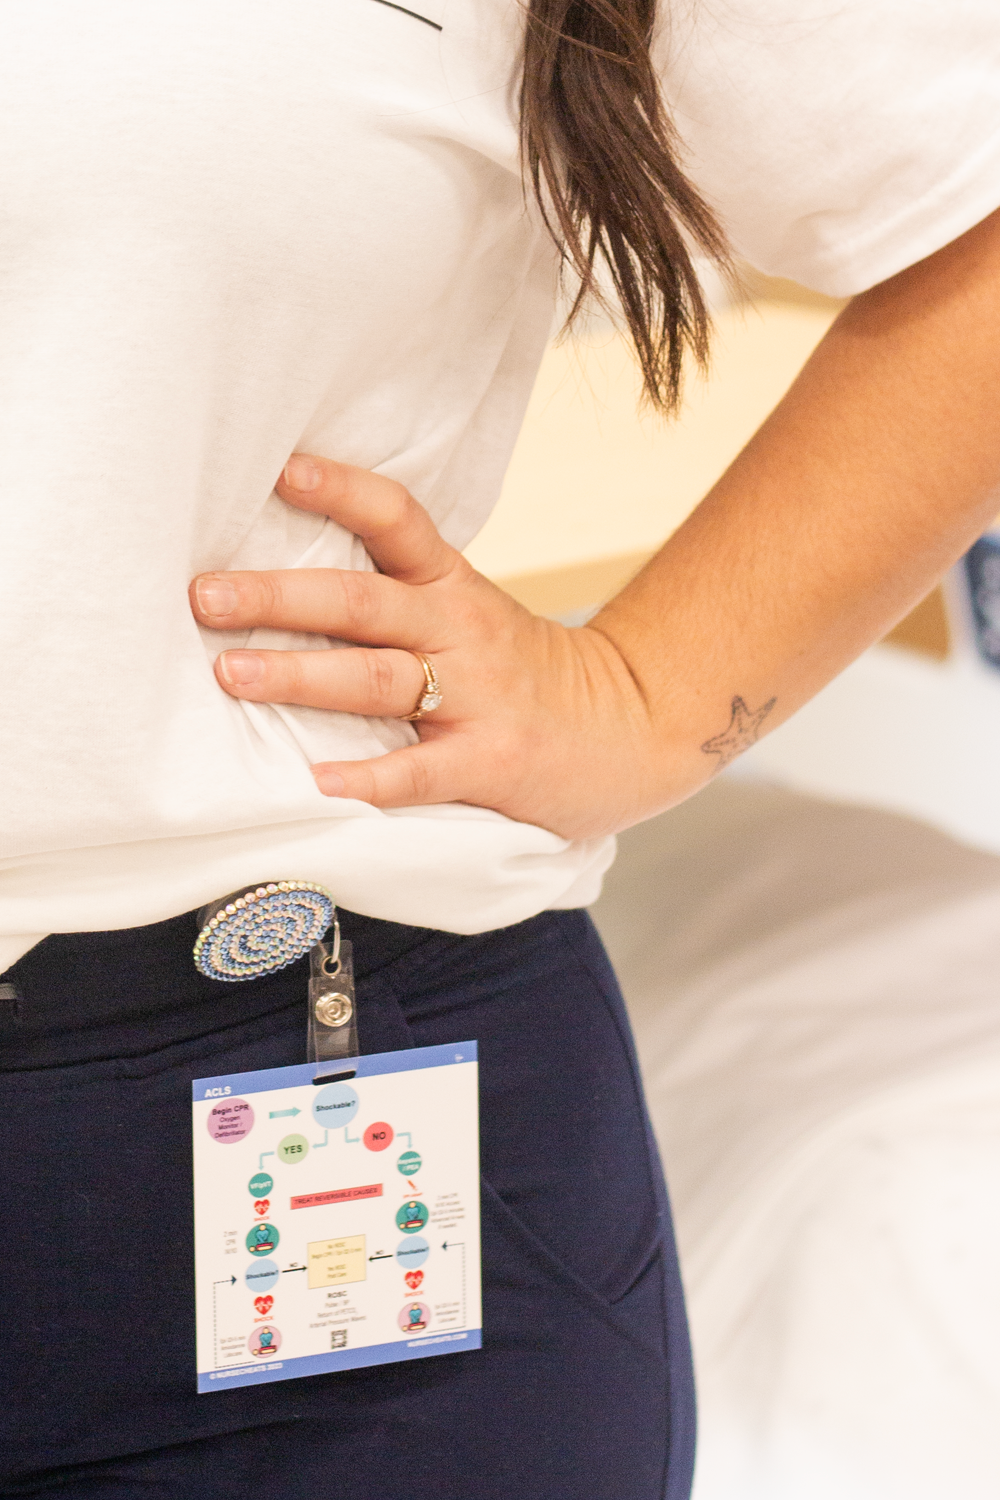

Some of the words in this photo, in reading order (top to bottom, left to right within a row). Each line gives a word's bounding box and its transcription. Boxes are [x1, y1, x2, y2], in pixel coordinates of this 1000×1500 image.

[204, 1086, 232, 1098] ACLS
[212, 1106, 233, 1116] Begin
[234, 1104, 250, 1113] CPR
[315, 1100, 356, 1112] Shockable?
[372, 1131, 387, 1141] NO
[283, 1144, 303, 1155] YES
